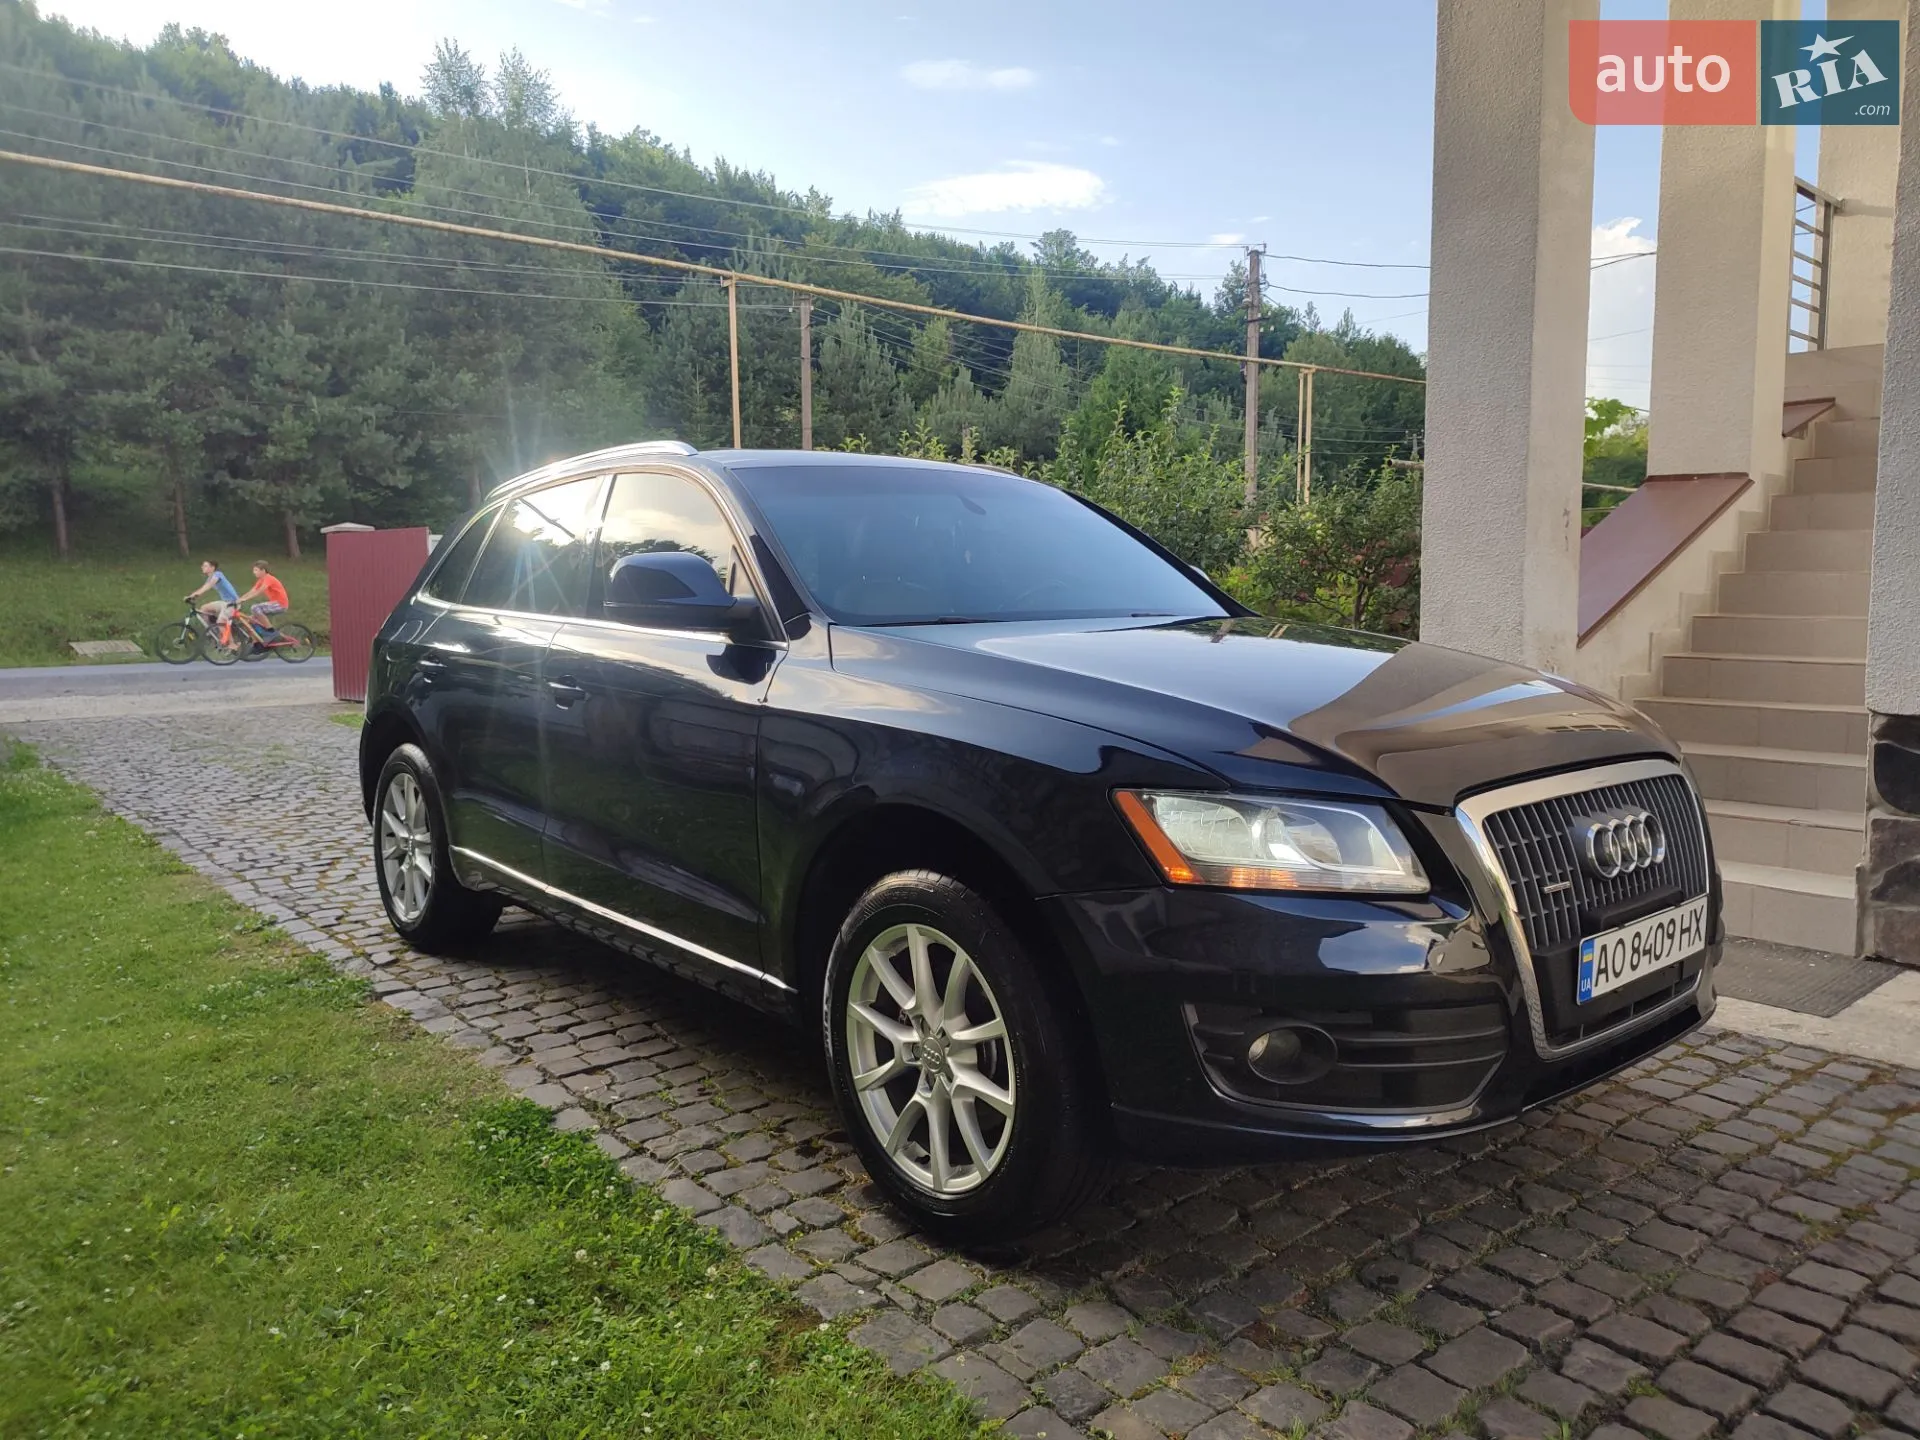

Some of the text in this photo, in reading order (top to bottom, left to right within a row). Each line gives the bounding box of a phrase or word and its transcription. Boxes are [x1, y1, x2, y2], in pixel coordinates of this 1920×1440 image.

[1594, 904, 1704, 988] AO 8409 HX
[1581, 977, 1592, 992] UA
